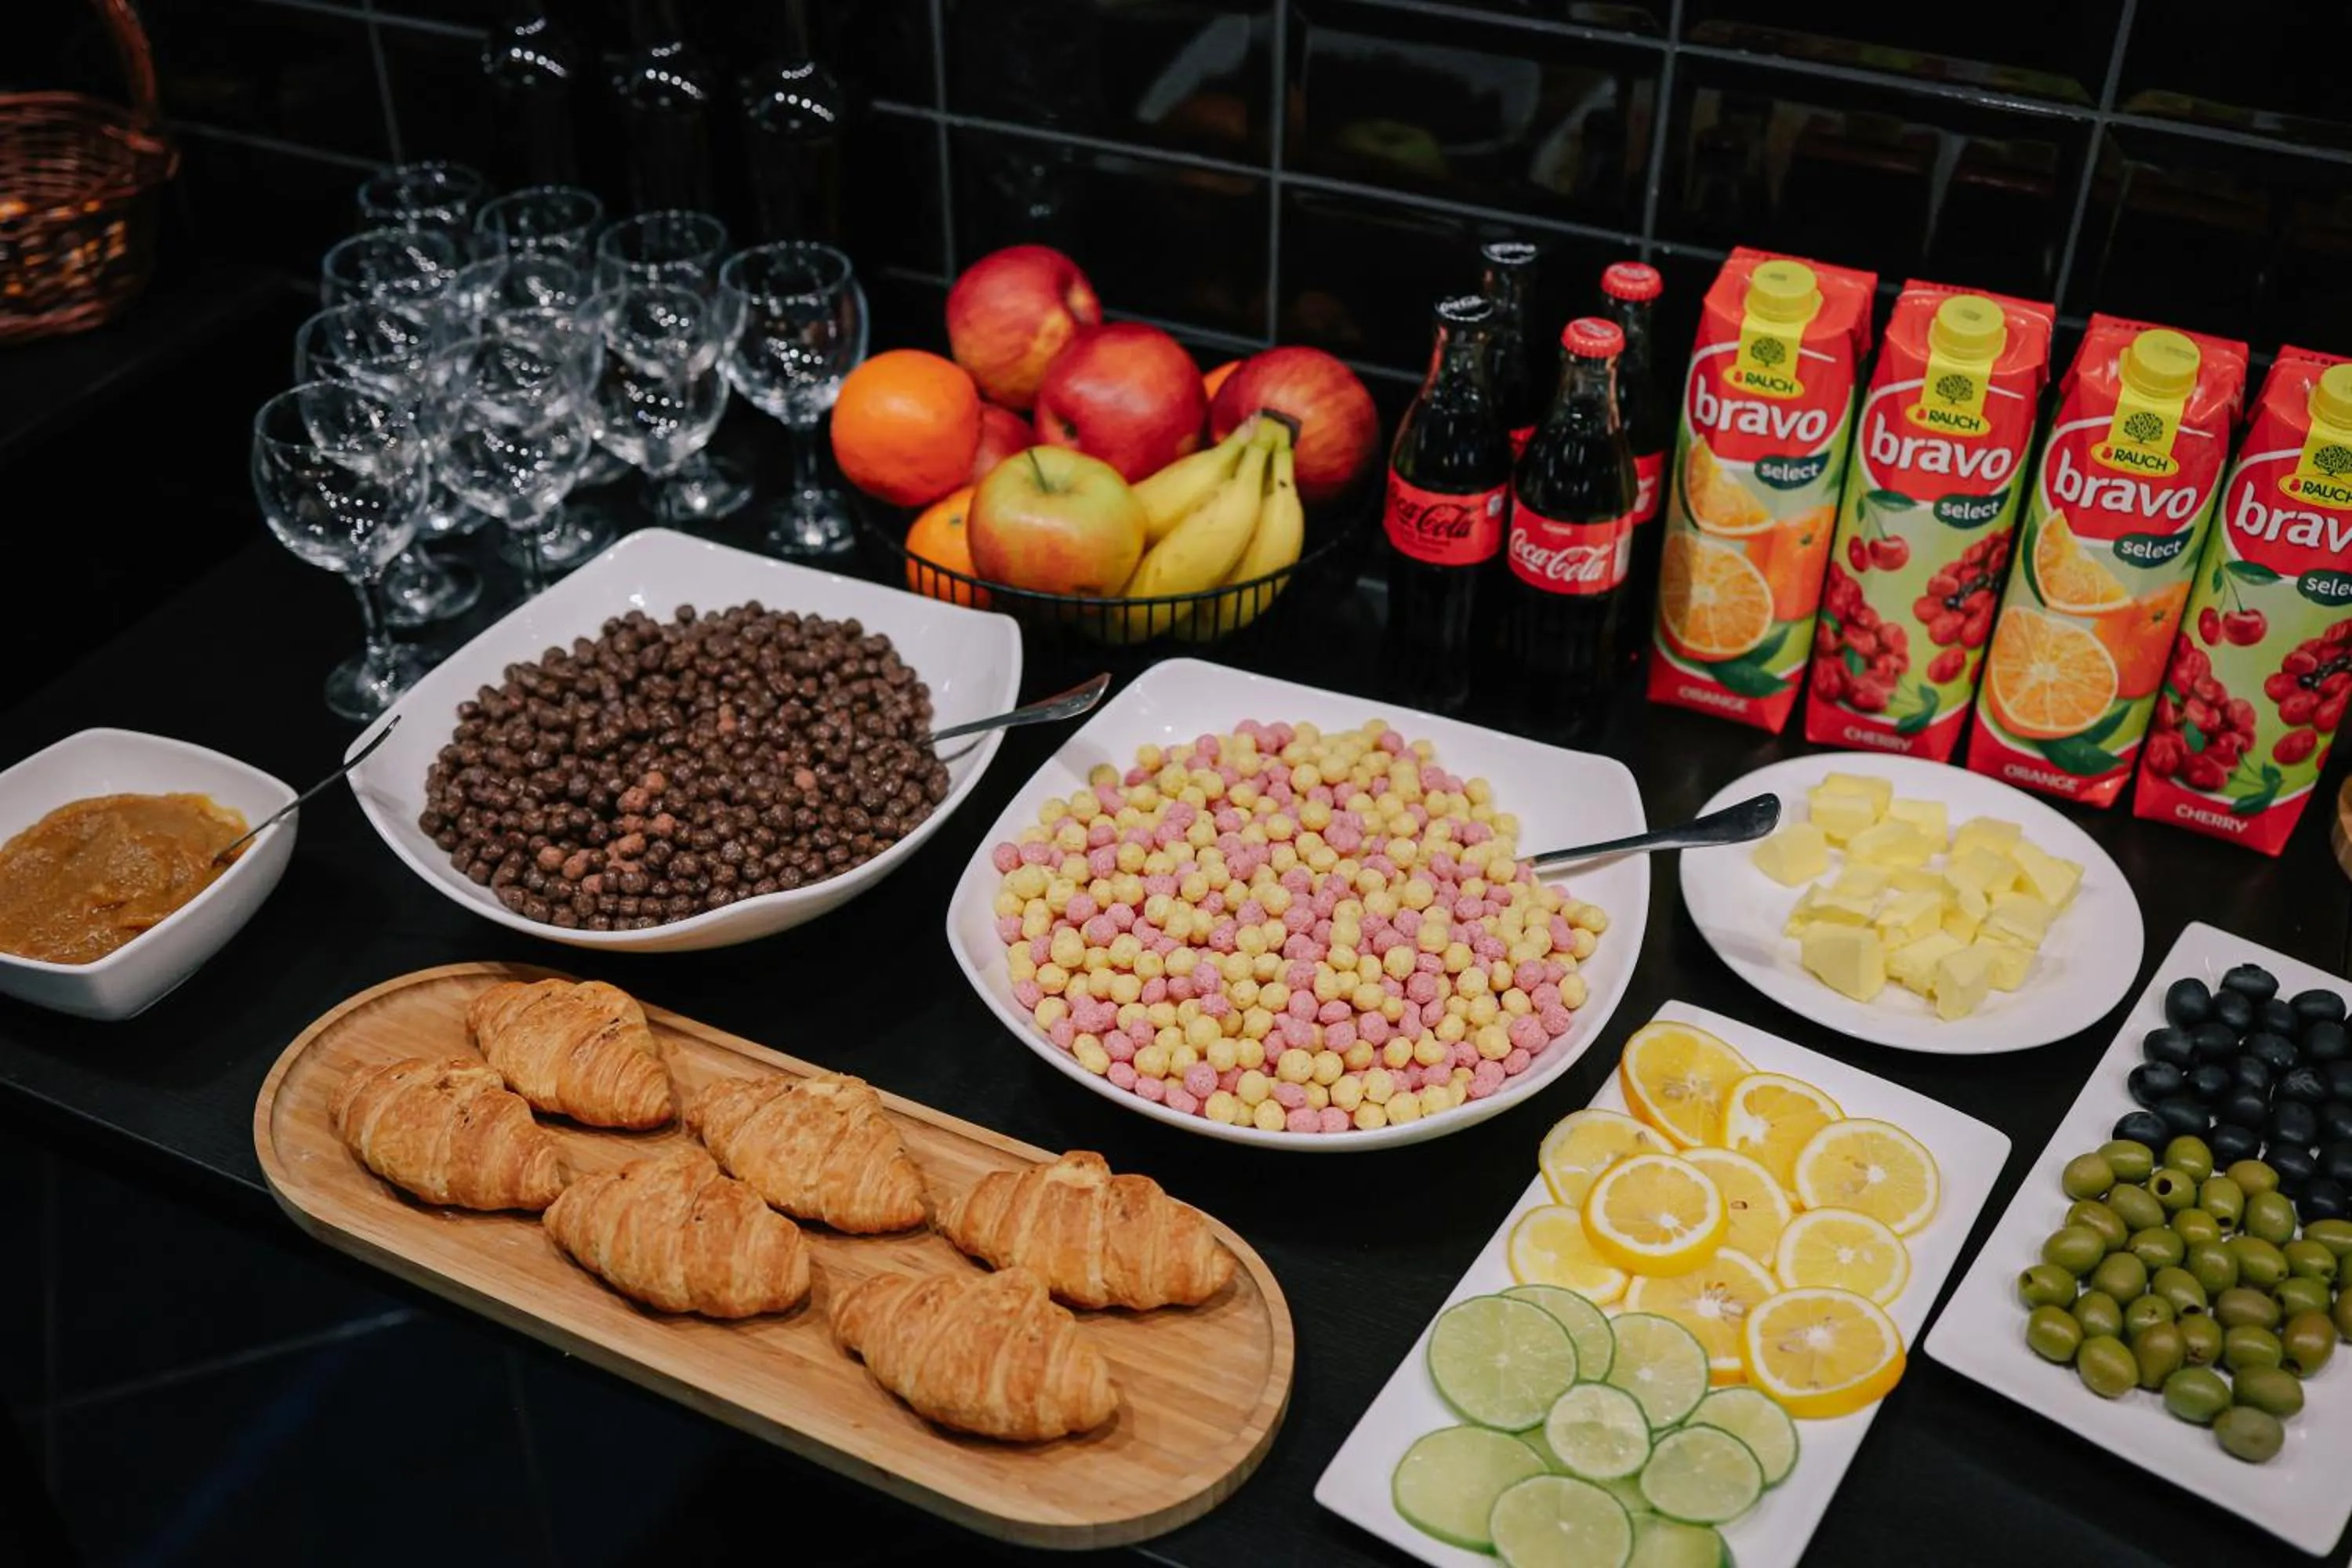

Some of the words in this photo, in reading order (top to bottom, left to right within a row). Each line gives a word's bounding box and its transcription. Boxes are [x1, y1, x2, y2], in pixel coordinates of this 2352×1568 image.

[1745, 372, 1793, 394] RAUCH
[1695, 373, 1828, 442] bravo
[1928, 409, 1980, 431] RAUCH
[1871, 412, 2012, 481] bravo
[2114, 448, 2168, 471] RAUCH
[1761, 463, 1819, 481] select
[2054, 448, 2197, 519] bravo
[1941, 502, 1999, 520] select
[2235, 480, 2352, 553] brav
[1509, 528, 1610, 582] Coca-Cola
[2121, 540, 2181, 559] select
[2306, 576, 2352, 597] sele
[1843, 725, 1913, 752] CHERRY
[2003, 764, 2078, 793] ORANGE
[2175, 803, 2249, 833] CHERRY
